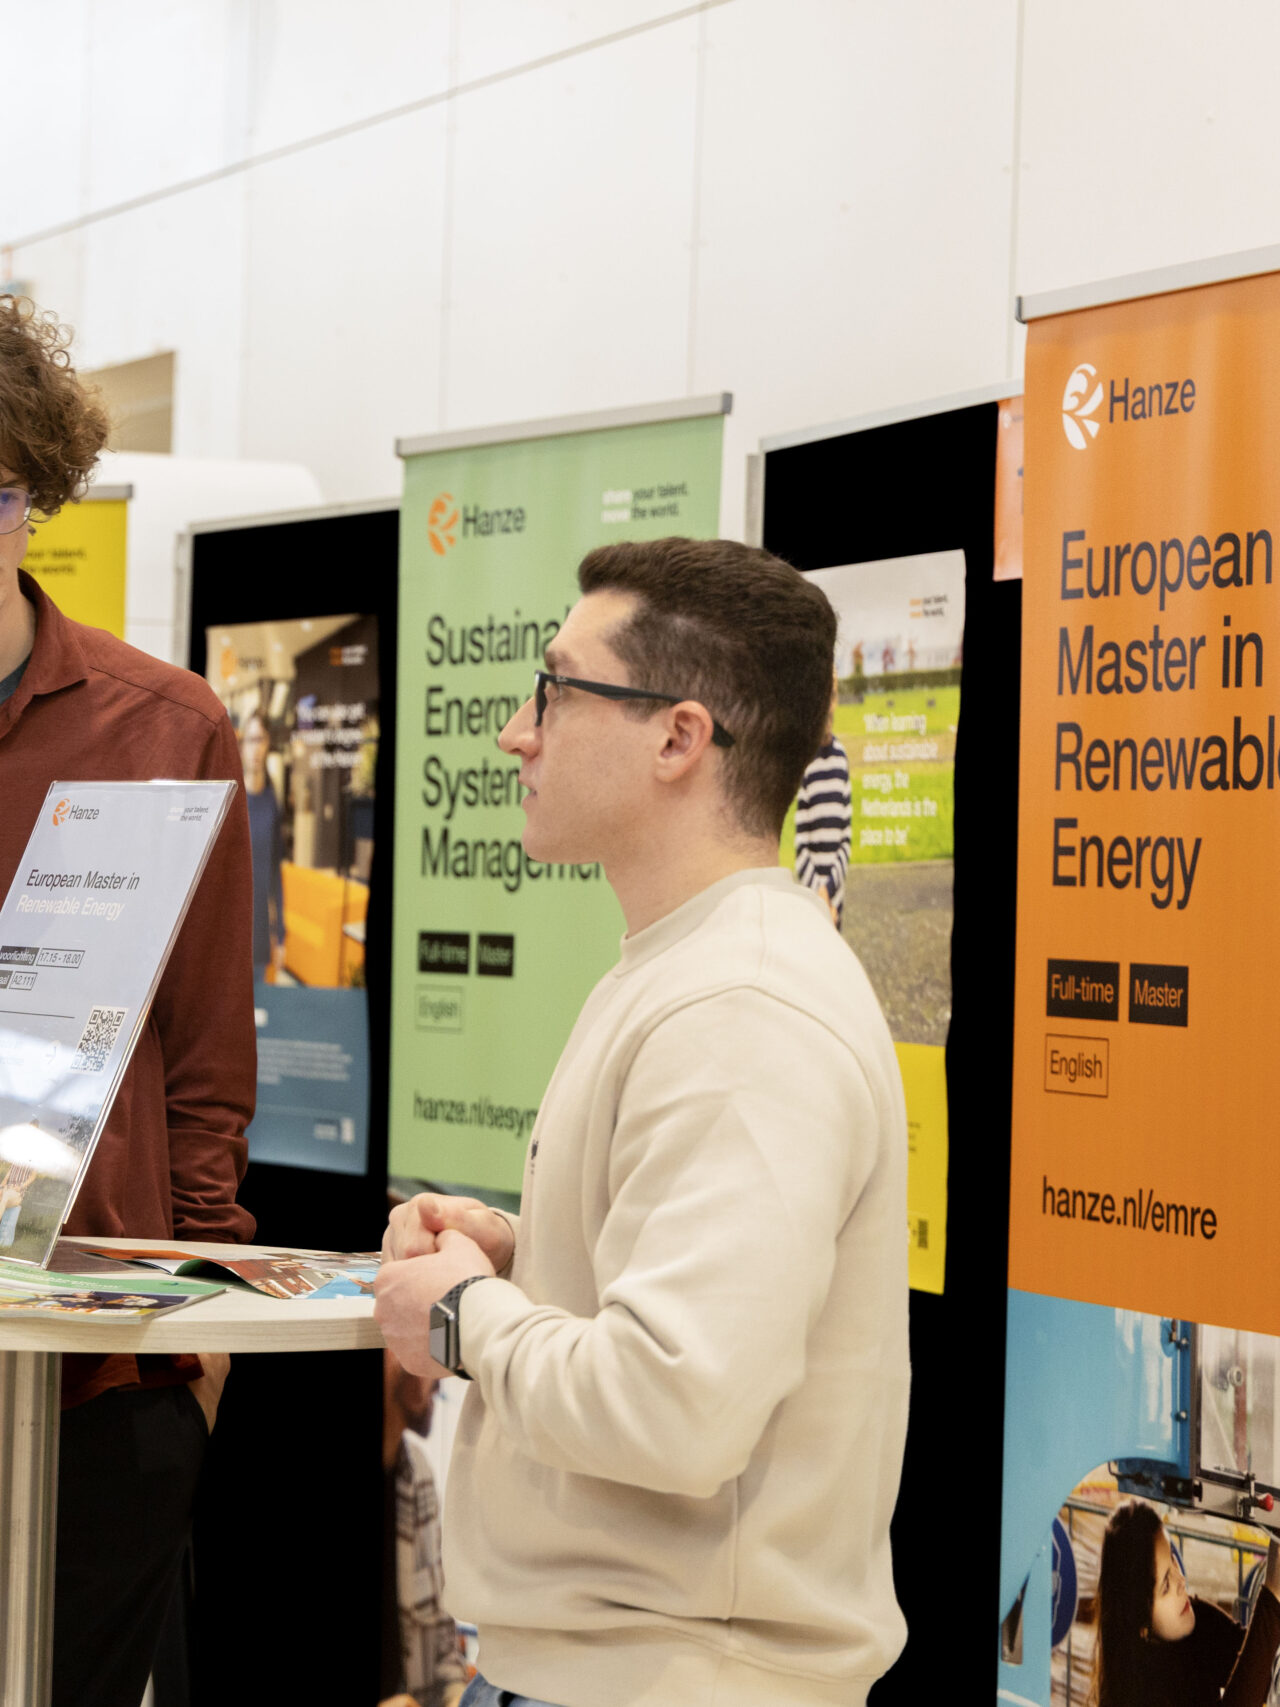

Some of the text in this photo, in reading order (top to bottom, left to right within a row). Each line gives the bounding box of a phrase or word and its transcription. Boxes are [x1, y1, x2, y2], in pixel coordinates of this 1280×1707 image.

[1109, 377, 1196, 424] Hanze
[462, 505, 526, 539] Hanze
[1061, 528, 1273, 611] European
[426, 605, 572, 668] Sustaina
[1057, 615, 1263, 696] Master in
[426, 685, 531, 748] Energ
[1055, 715, 1280, 792] Renewabl
[70, 804, 100, 821] Hanze
[26, 869, 140, 891] European Master in
[1052, 817, 1203, 910] Energy
[15, 894, 126, 920] Renewable Energy
[0, 948, 36, 964] voorlichting
[40, 952, 58, 963] 17.15
[1051, 974, 1184, 1009] Full-time Master
[1050, 1050, 1103, 1083] English
[1042, 1175, 1218, 1240] hanze.nl/emre
